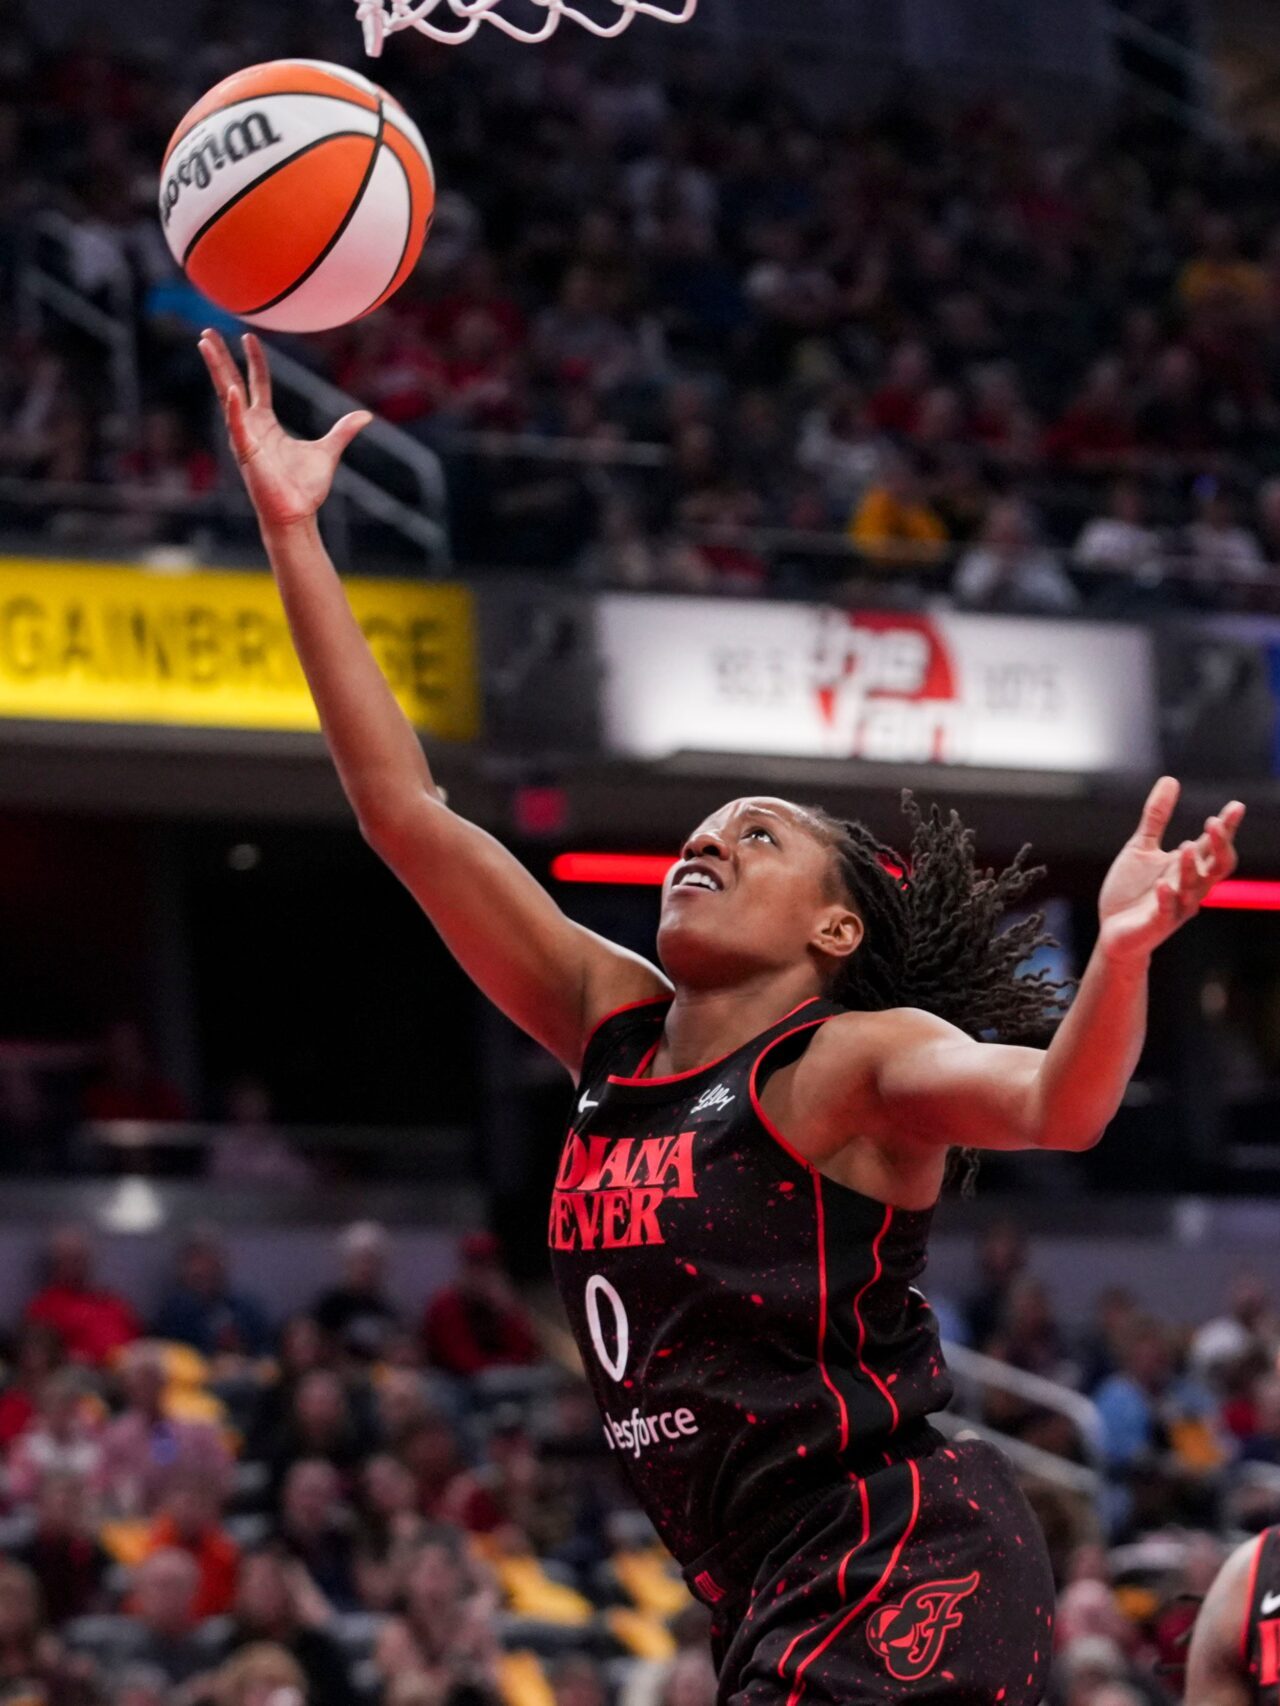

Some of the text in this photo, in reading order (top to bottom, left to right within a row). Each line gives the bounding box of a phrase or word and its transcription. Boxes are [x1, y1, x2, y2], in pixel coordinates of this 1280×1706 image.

[690, 1083, 736, 1114] Lilly
[554, 1128, 698, 1198] DIANA
[548, 1187, 666, 1250] EVER
[585, 1274, 629, 1382] 0
[603, 1407, 699, 1458] lesforce
